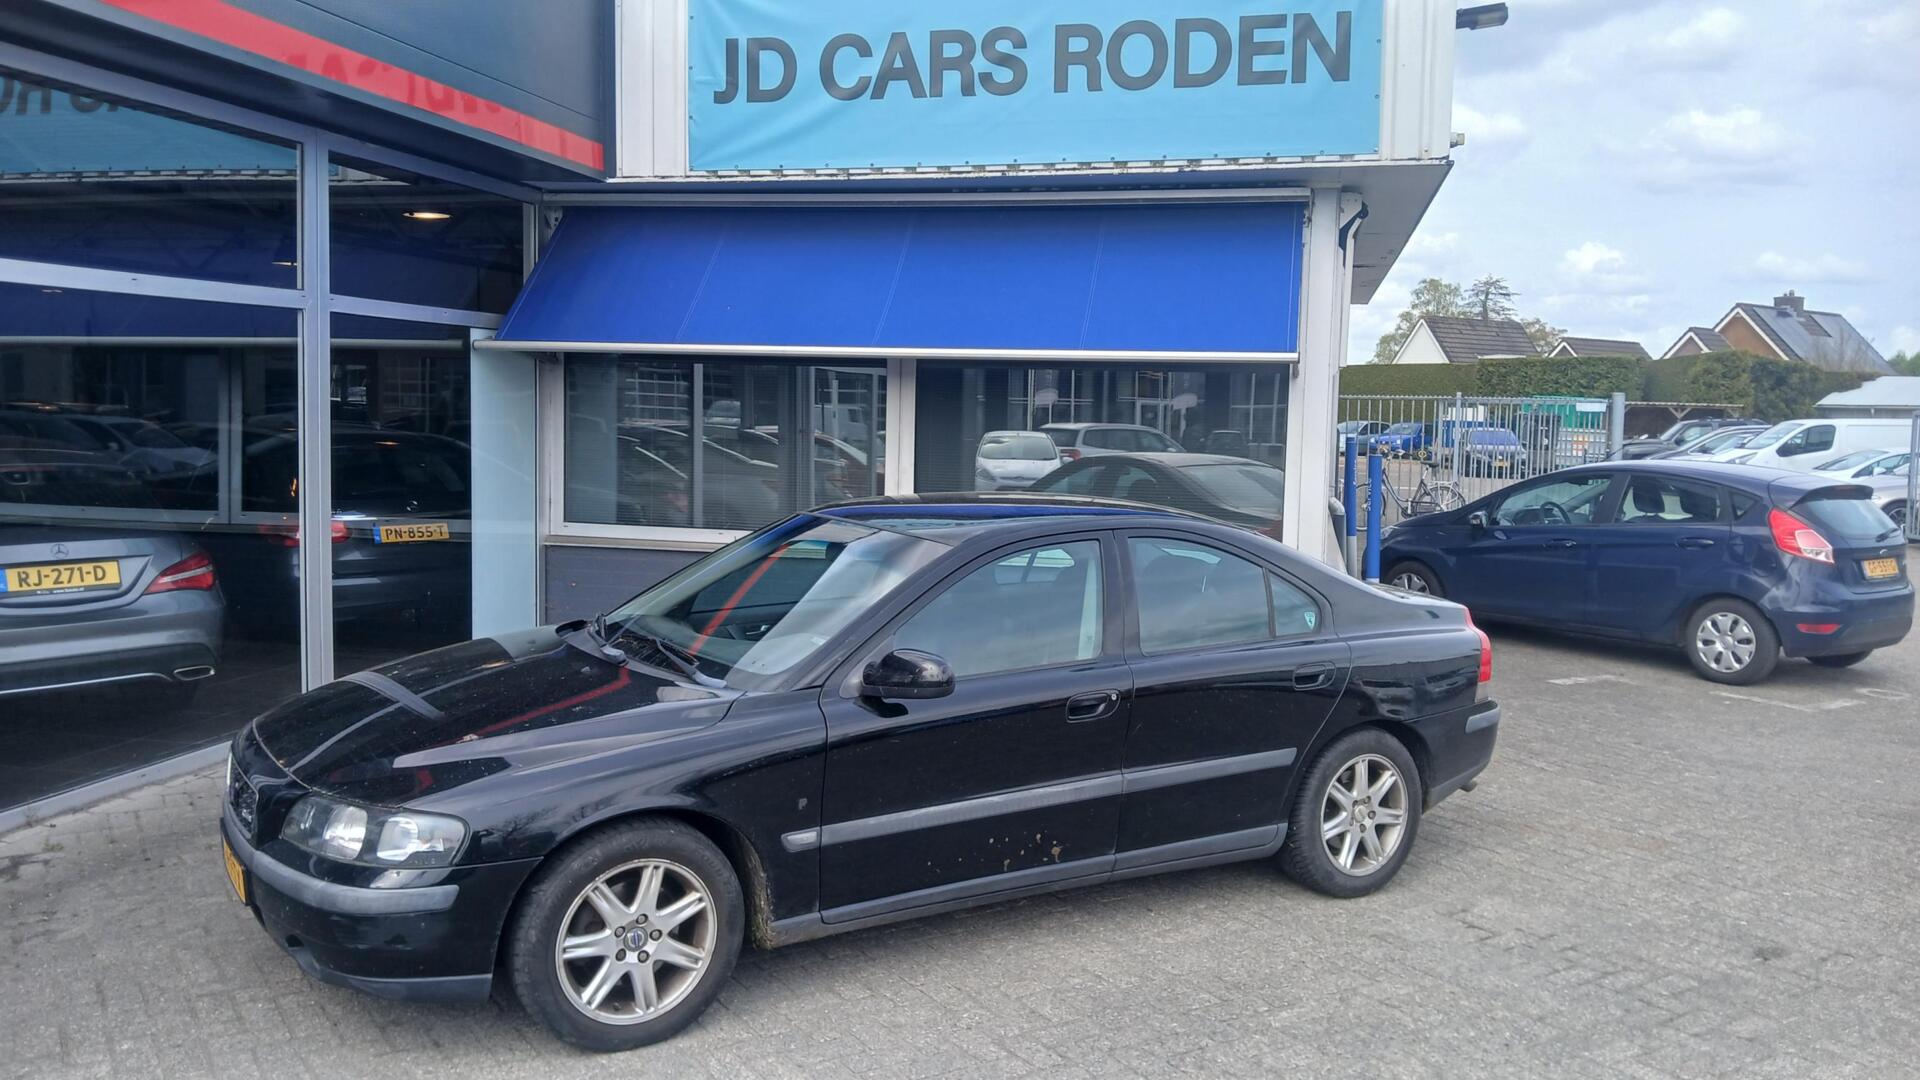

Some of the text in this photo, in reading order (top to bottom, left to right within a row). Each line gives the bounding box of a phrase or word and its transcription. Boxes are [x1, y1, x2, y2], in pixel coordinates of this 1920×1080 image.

[713, 11, 1352, 104] JD CARS RODEN
[385, 525, 445, 541] PN-855-T
[17, 565, 107, 588] RJ-271-D
